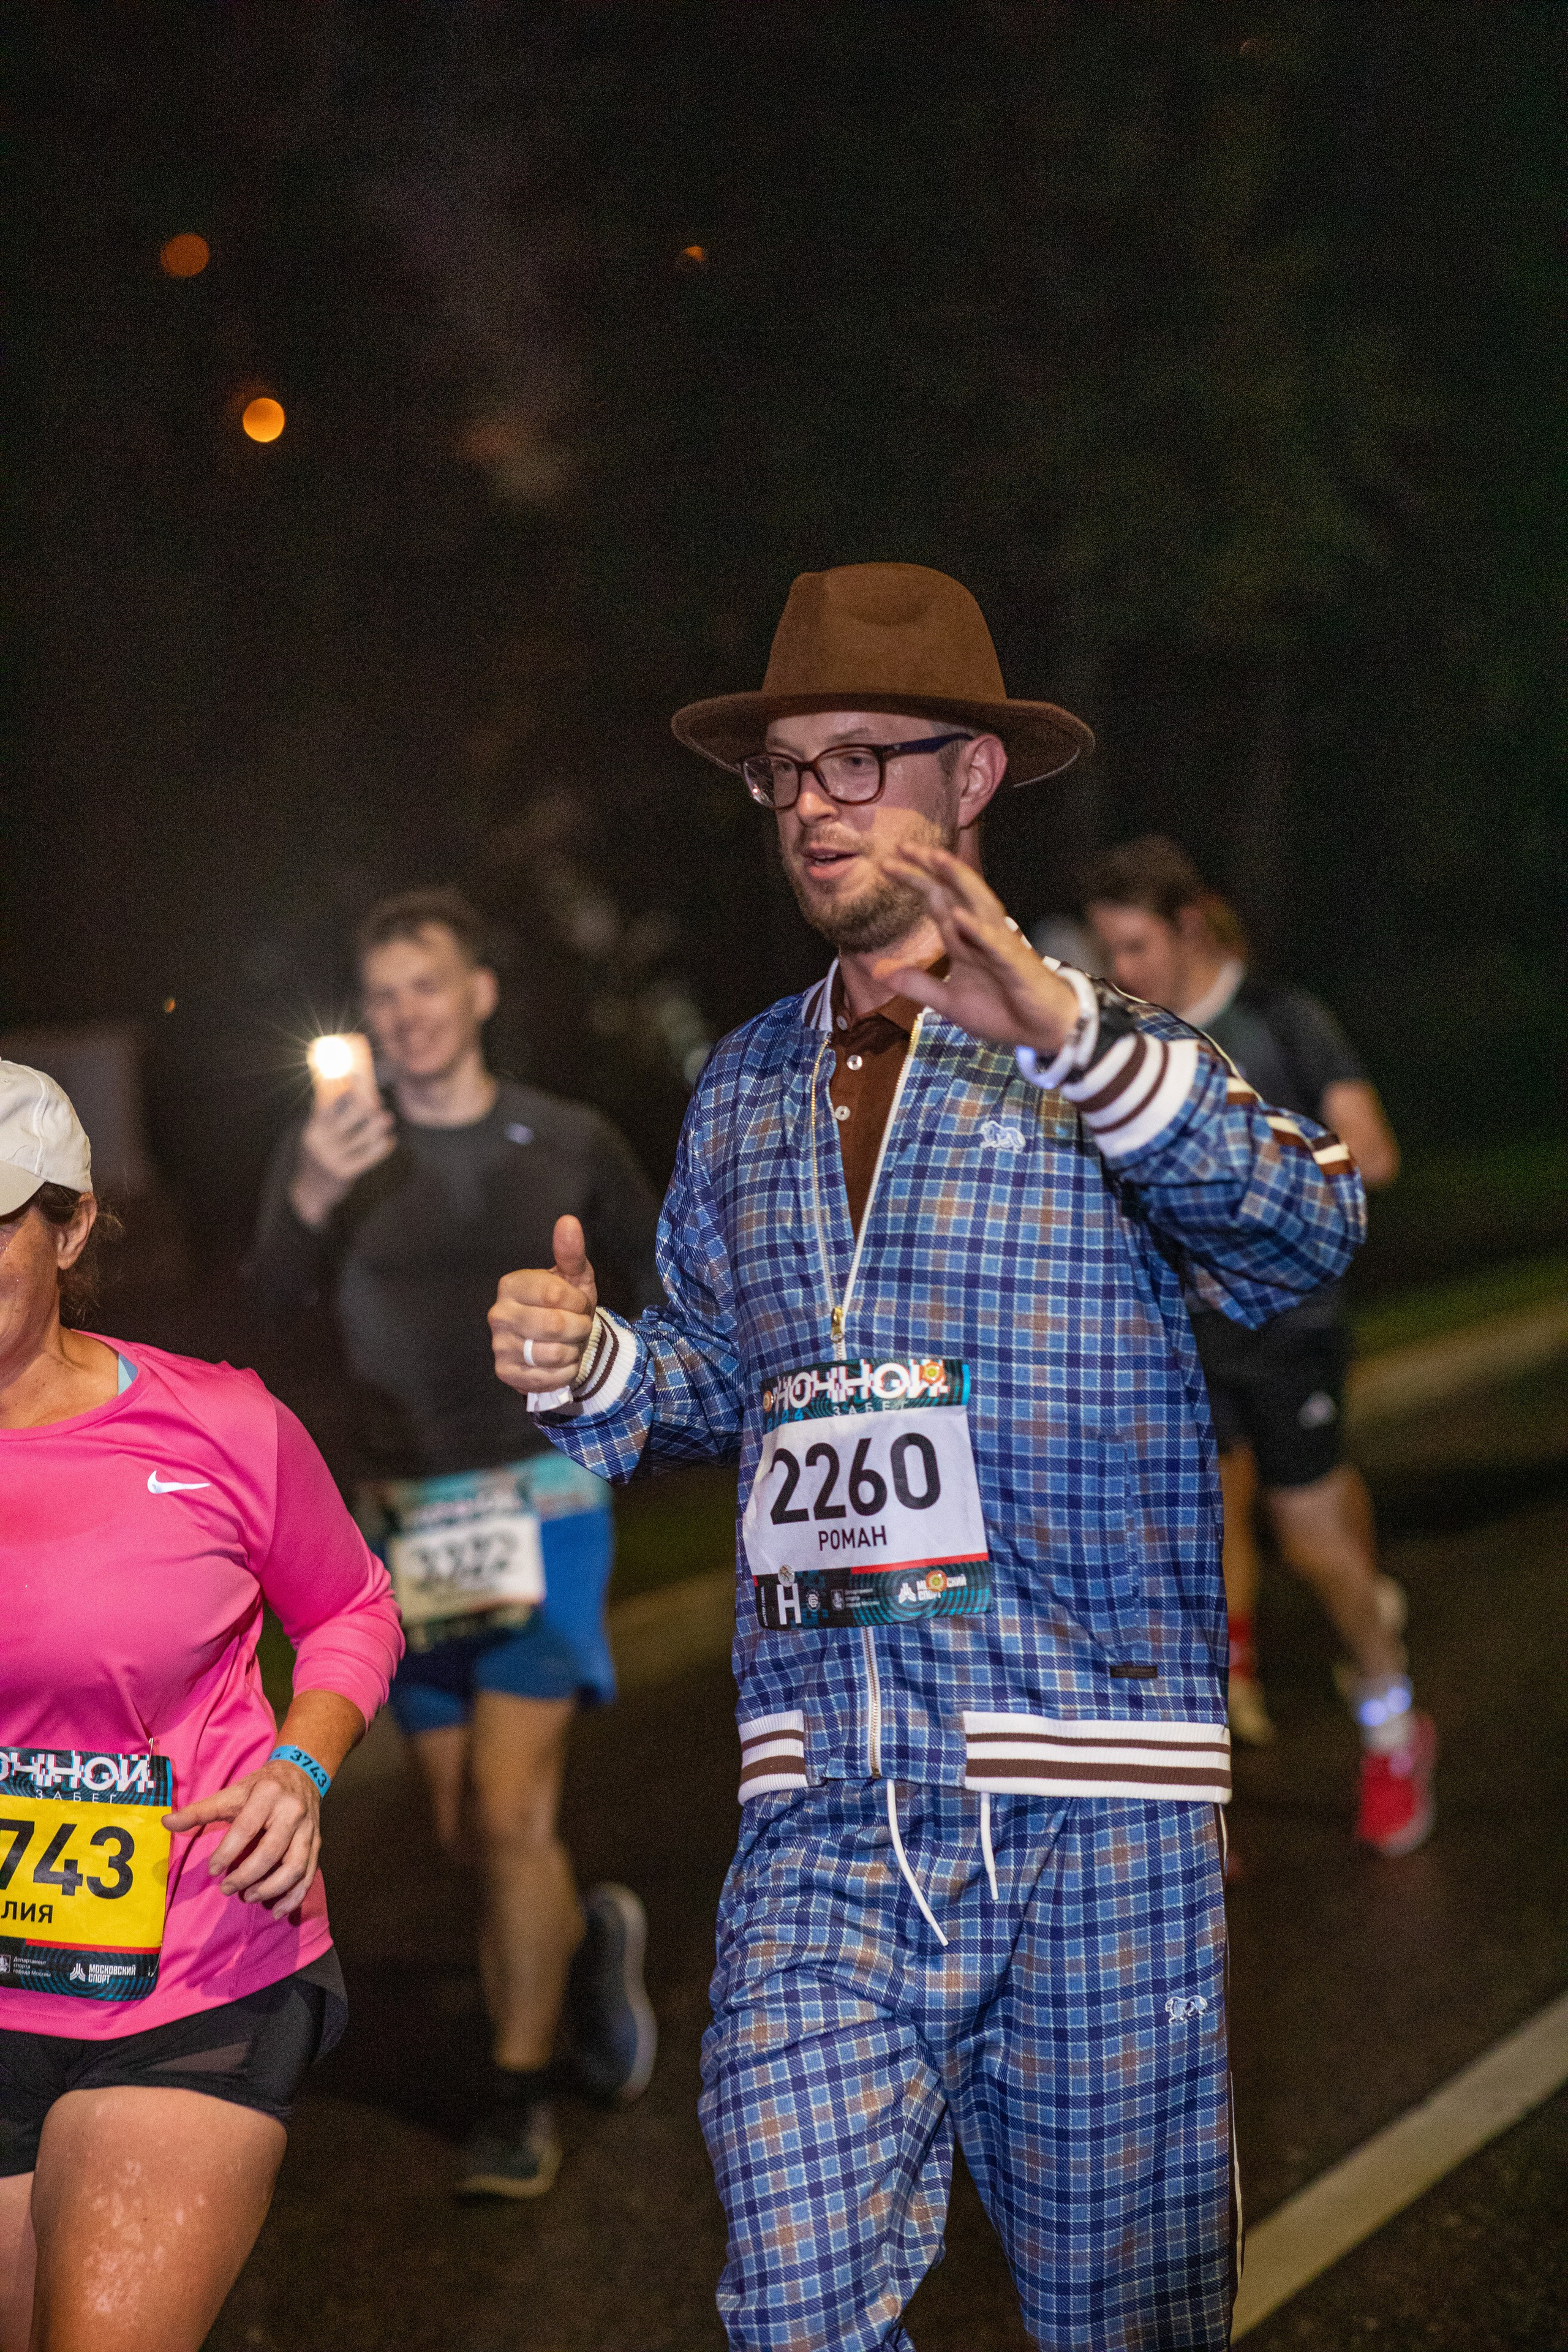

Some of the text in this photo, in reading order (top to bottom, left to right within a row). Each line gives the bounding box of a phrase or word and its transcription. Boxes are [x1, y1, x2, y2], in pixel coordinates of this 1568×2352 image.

[770, 1433, 941, 1525] 2260
[819, 1525, 888, 1551] РОМАН
[290, 1750, 327, 1787] 3743
[36, 1789, 117, 1804] ЗАБЕГ
[0, 1819, 135, 1899] 743
[1, 1901, 53, 1923] ЛИЯ
[88, 1974, 111, 1984] СПОРТ
[89, 1964, 136, 1976] МОСКОВСКИЙ
